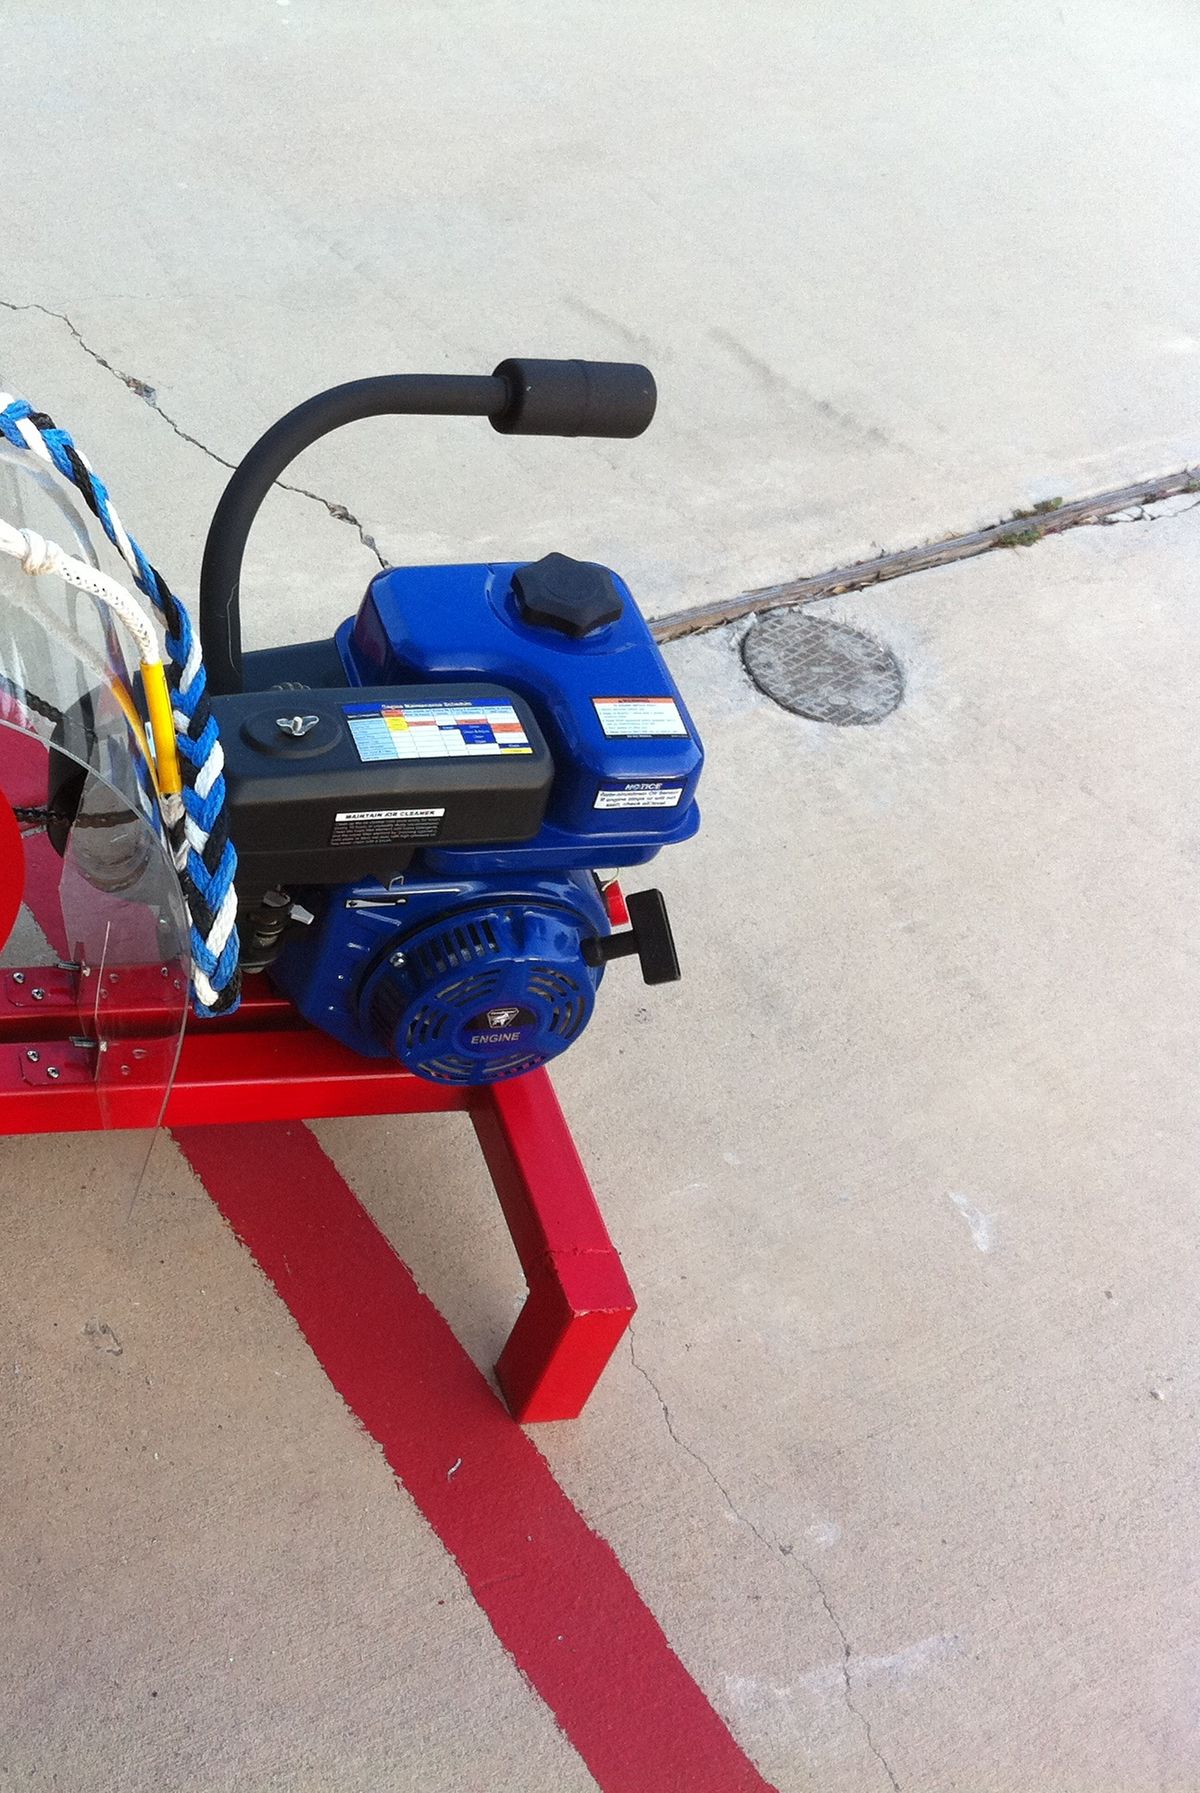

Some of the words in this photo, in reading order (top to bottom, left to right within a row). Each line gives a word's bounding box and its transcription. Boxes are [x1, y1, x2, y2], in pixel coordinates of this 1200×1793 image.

[625, 782, 663, 791] NOTICE
[345, 812, 383, 820] MAINTAIN
[471, 1031, 521, 1044] ENGINE
